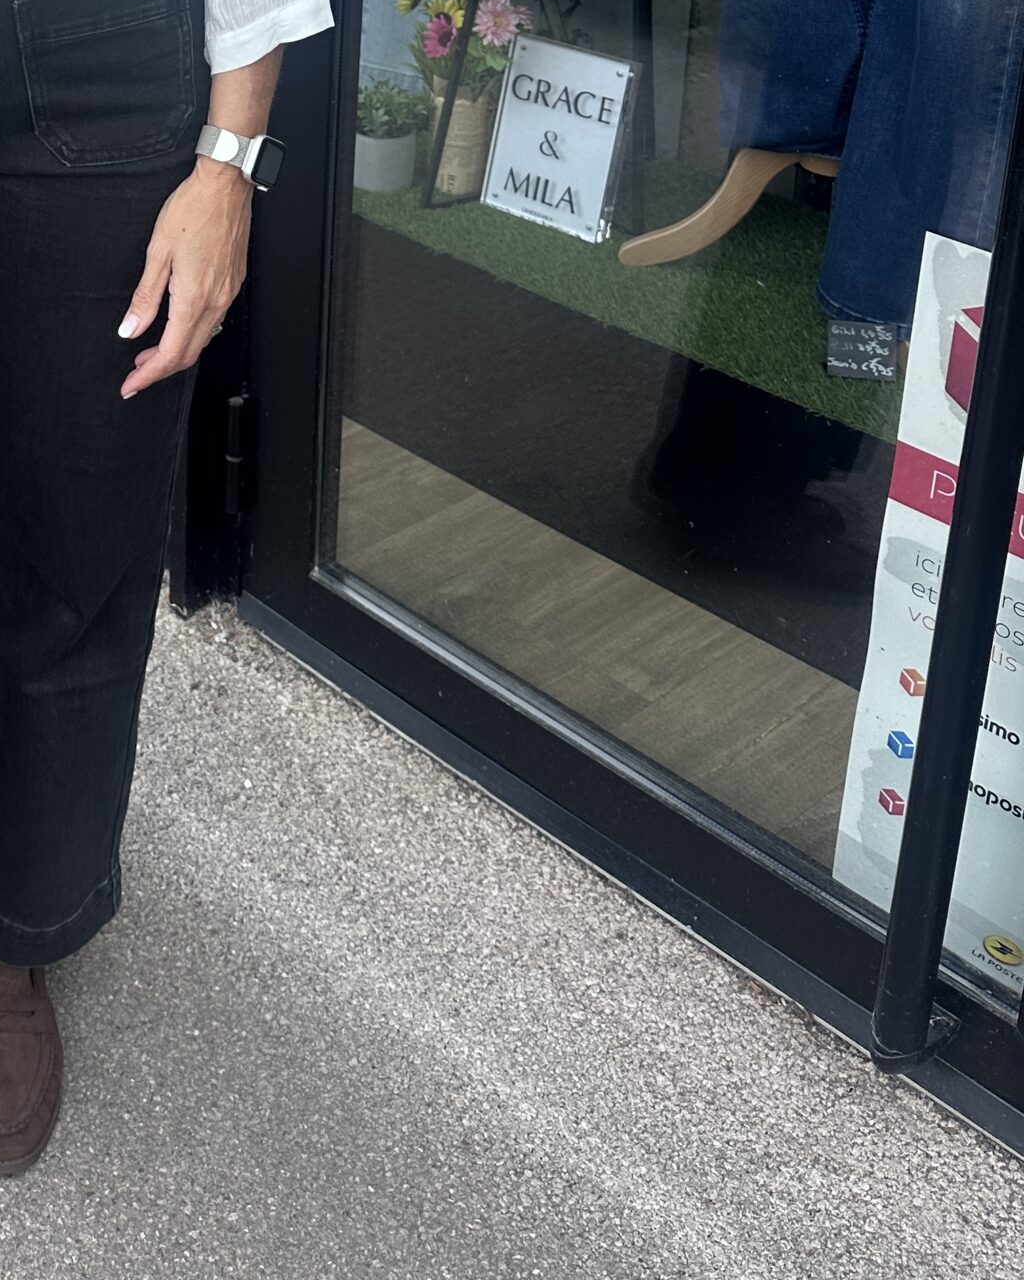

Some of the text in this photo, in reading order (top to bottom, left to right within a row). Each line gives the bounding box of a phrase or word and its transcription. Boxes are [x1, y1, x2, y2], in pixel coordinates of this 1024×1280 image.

[512, 74, 614, 125] GRACE
[539, 130, 560, 160] &
[503, 167, 575, 214] MILA
[915, 549, 943, 578] ici
[911, 582, 938, 605] et
[971, 948, 1024, 985] LA POSTE
